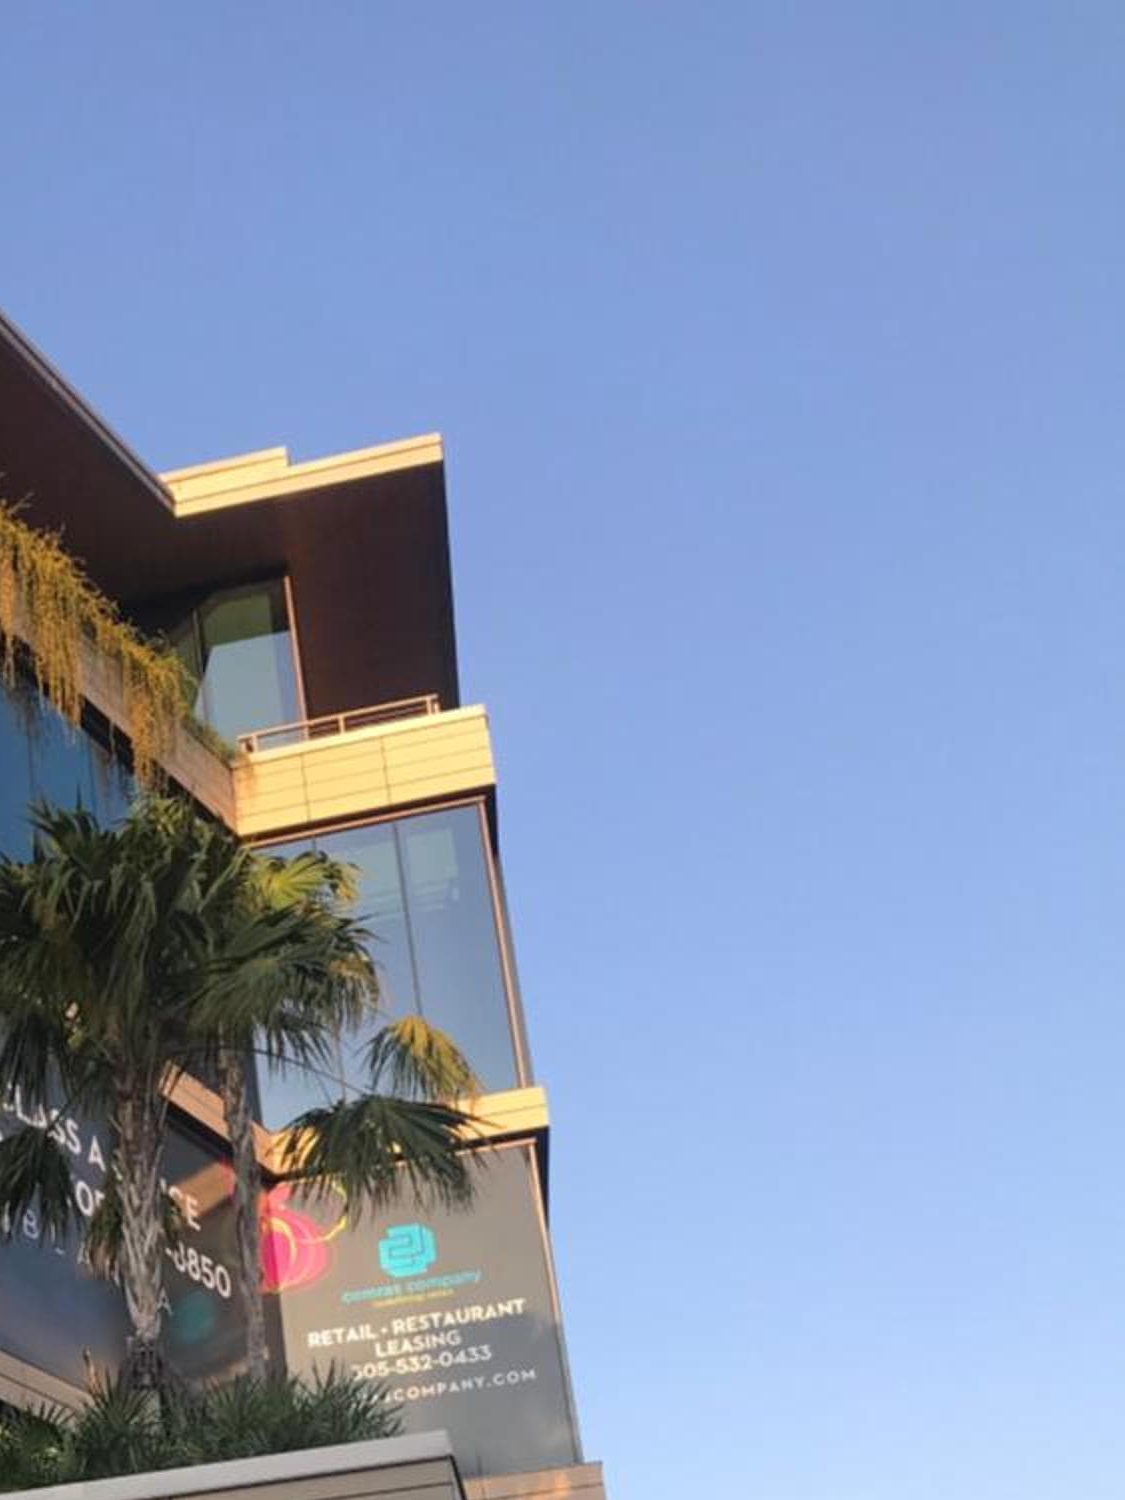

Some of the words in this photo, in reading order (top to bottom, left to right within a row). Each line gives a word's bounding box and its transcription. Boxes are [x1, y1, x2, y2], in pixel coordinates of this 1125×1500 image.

[88, 1135, 107, 1173] A
[307, 1323, 377, 1349] RETAIL
[392, 1298, 526, 1335] RESTAURANT
[374, 1330, 462, 1359] LEASING
